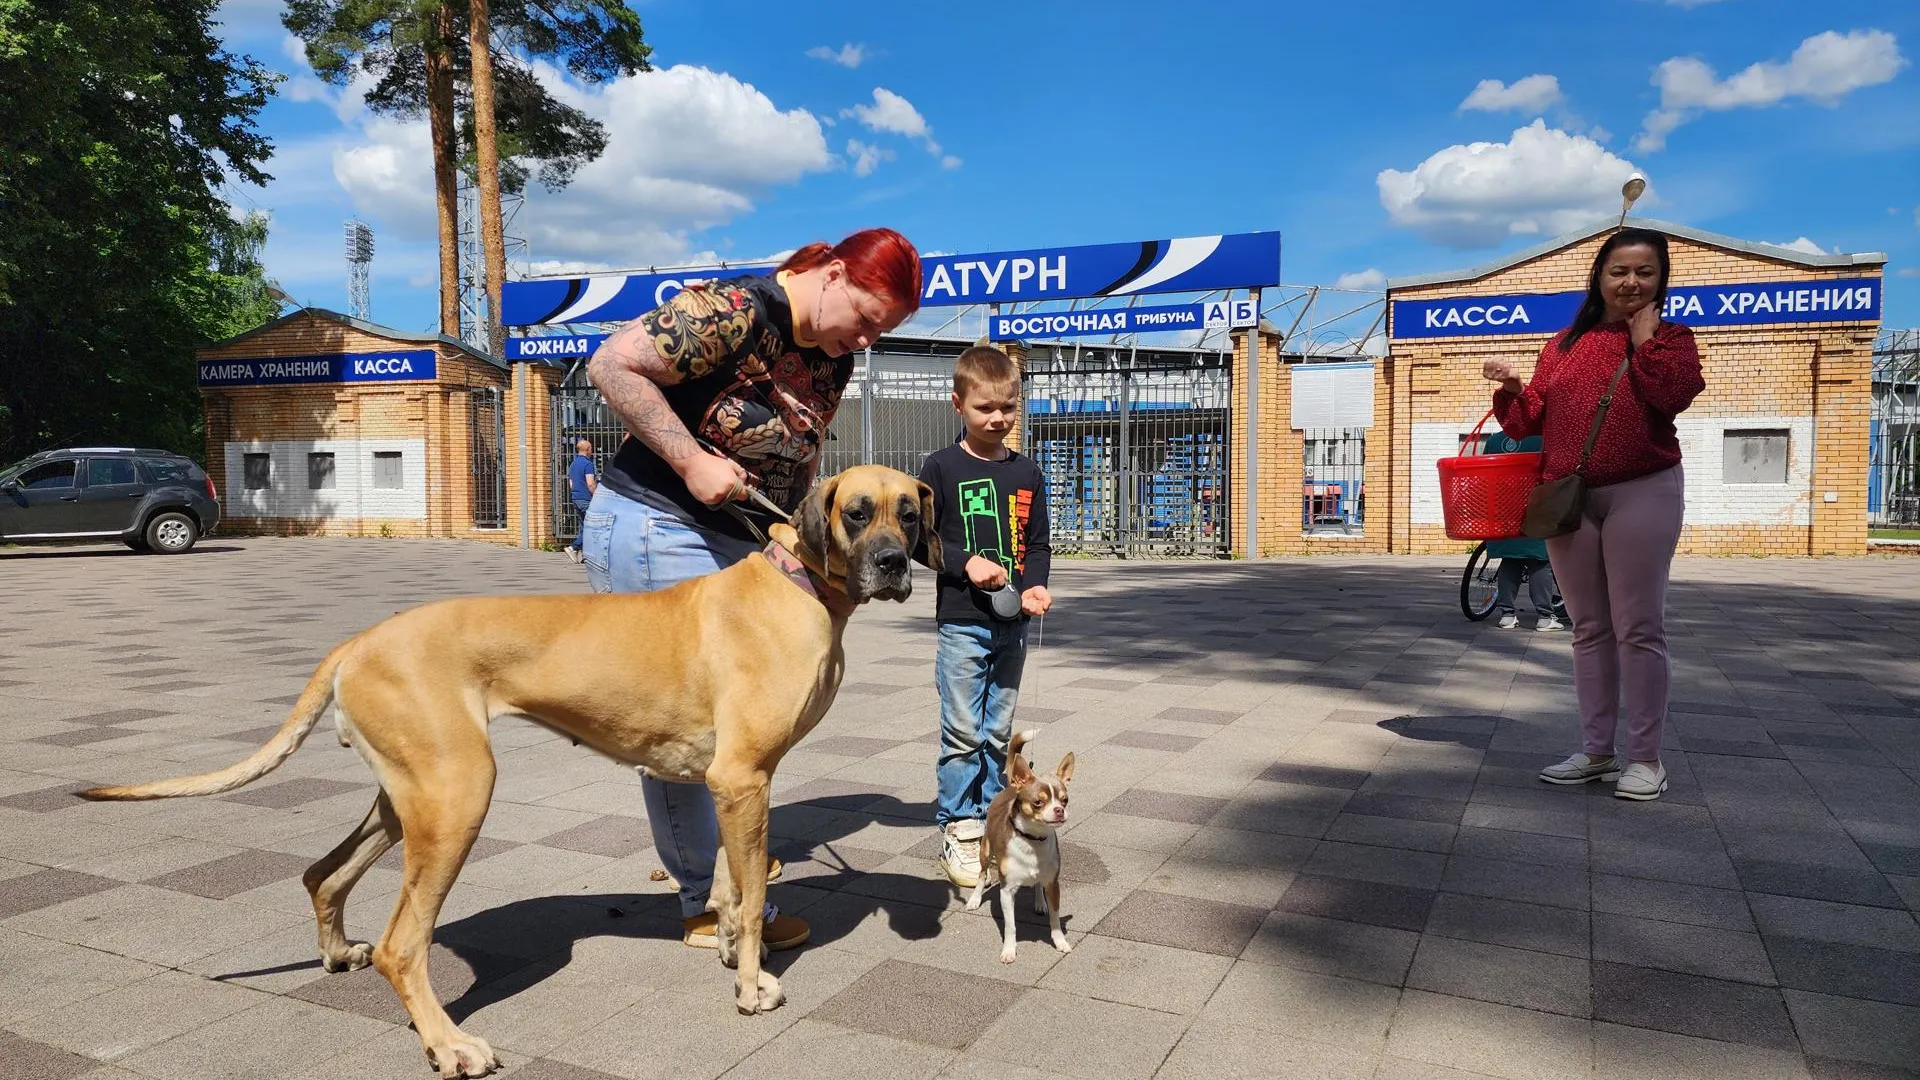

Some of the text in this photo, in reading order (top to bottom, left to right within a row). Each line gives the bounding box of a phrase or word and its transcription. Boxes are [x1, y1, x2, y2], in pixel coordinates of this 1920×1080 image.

[921, 255, 1067, 299] АТУРН
[1208, 302, 1252, 321] А Б
[1425, 287, 1872, 328] КАССА ЕРА ХРАНЕНИЯ
[999, 311, 1196, 336] ВОСТОЧНАЯ ТРИБУНА
[519, 338, 588, 356] ЮЖНАЯ
[200, 358, 413, 380] КАМЕРА ХРАНЕНИЯ КАССА
